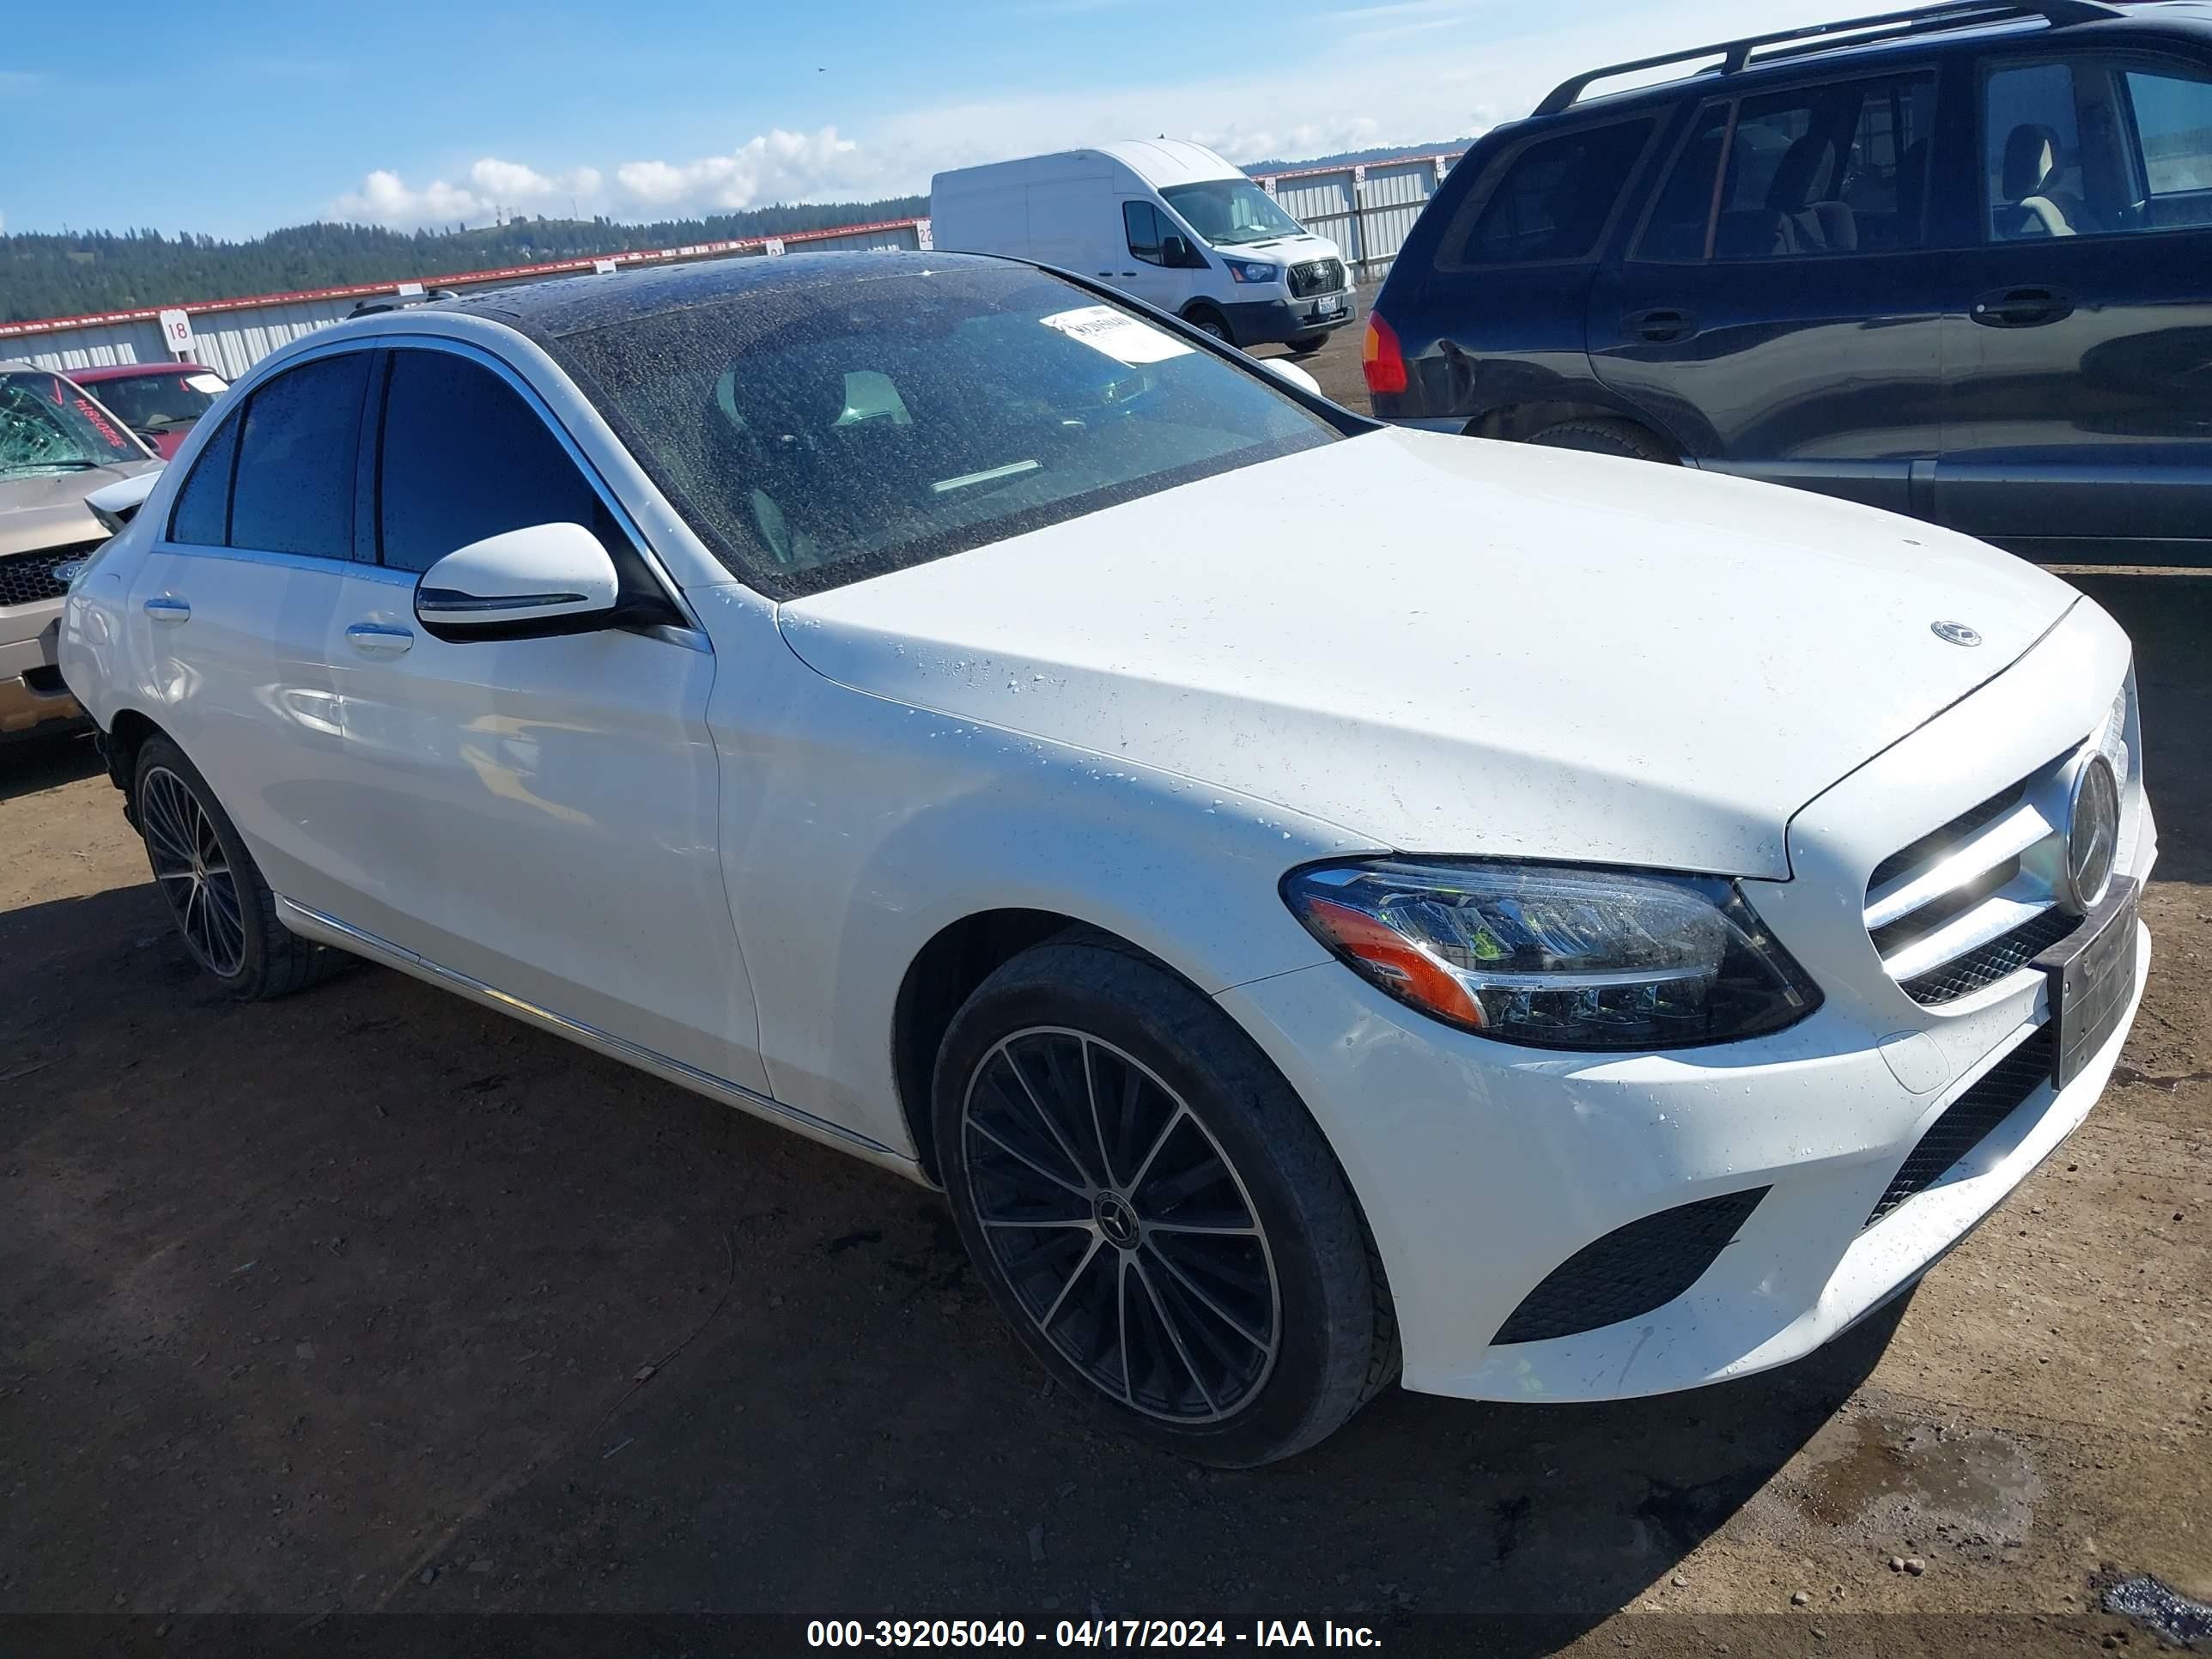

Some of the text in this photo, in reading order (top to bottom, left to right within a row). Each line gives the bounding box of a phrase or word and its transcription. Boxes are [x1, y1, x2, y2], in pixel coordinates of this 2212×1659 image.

[1356, 173, 1365, 183] 26
[1267, 184, 1275, 195] 25
[920, 228, 933, 242] 22
[168, 323, 188, 340] 18
